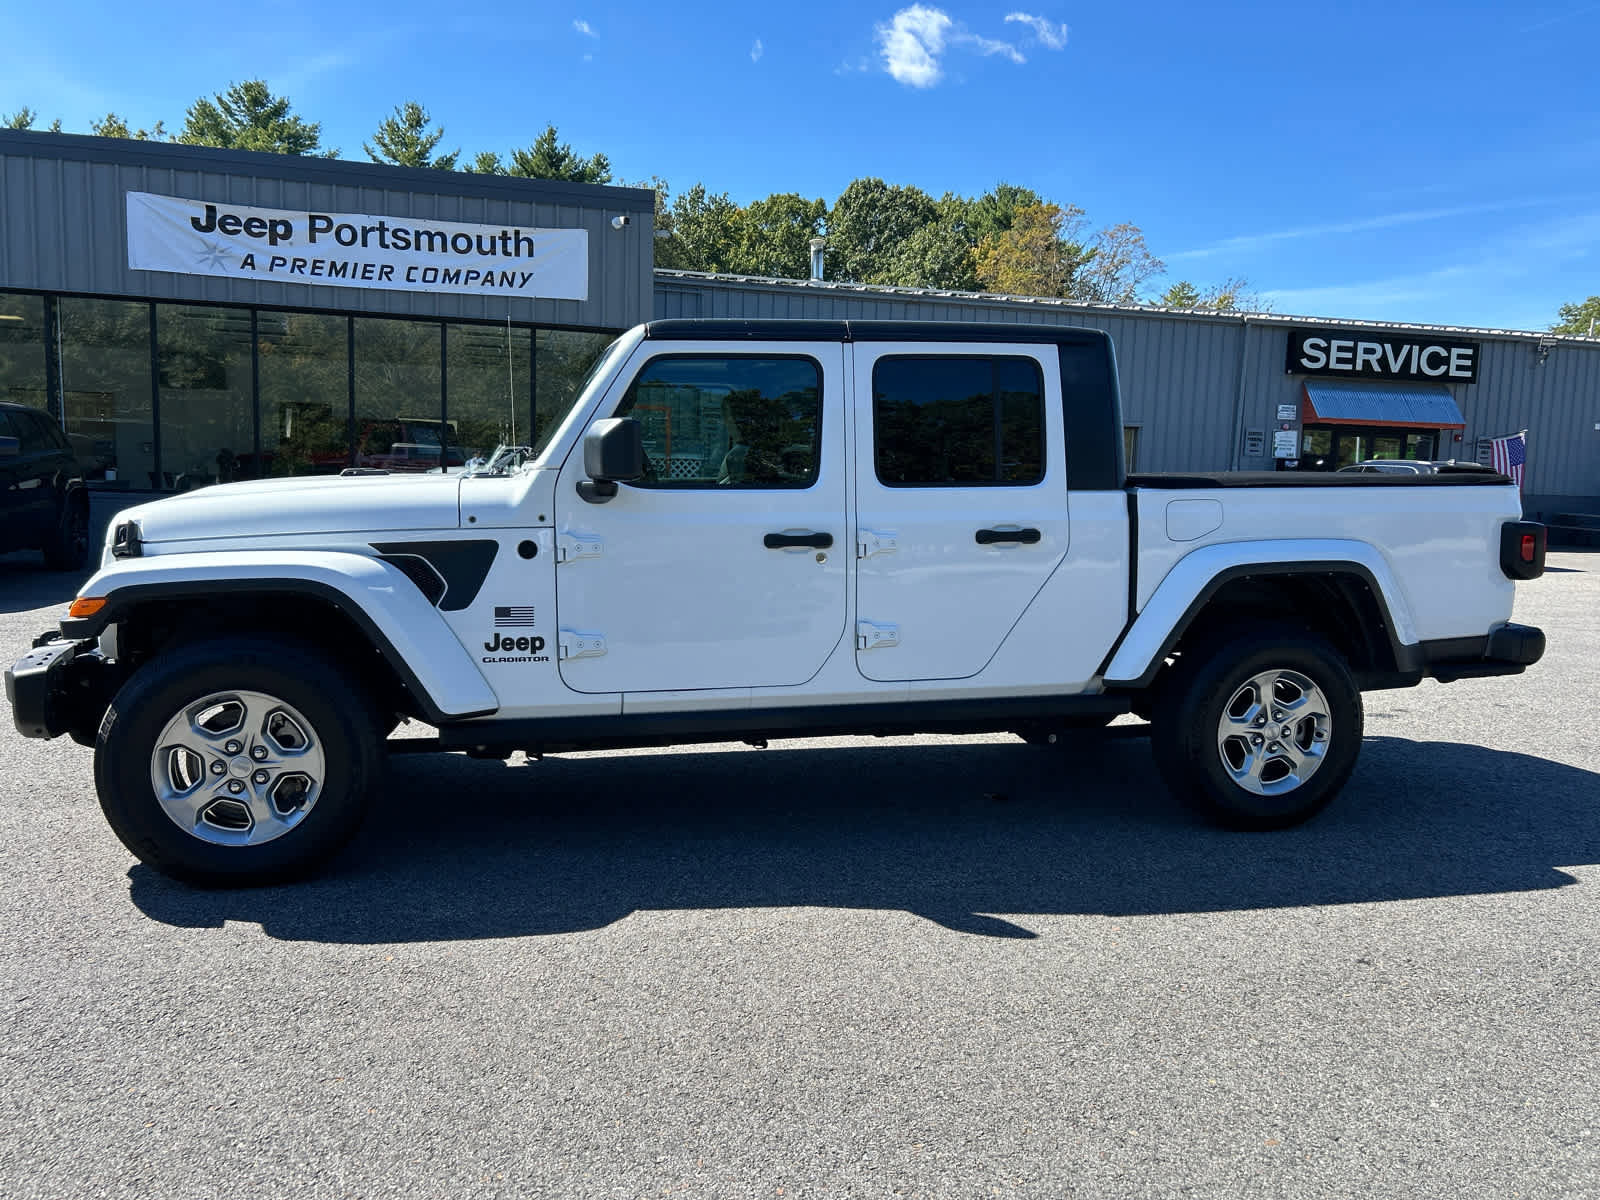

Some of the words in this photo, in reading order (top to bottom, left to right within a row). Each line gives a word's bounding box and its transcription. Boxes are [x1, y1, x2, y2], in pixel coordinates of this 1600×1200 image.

[191, 205, 293, 246] Jeep
[308, 214, 535, 258] Portsmouth
[240, 256, 256, 271] A
[268, 256, 396, 282] PREMIER
[405, 267, 534, 289] COMPANY
[1300, 337, 1473, 377] SERVICE
[484, 633, 545, 654] Jeep
